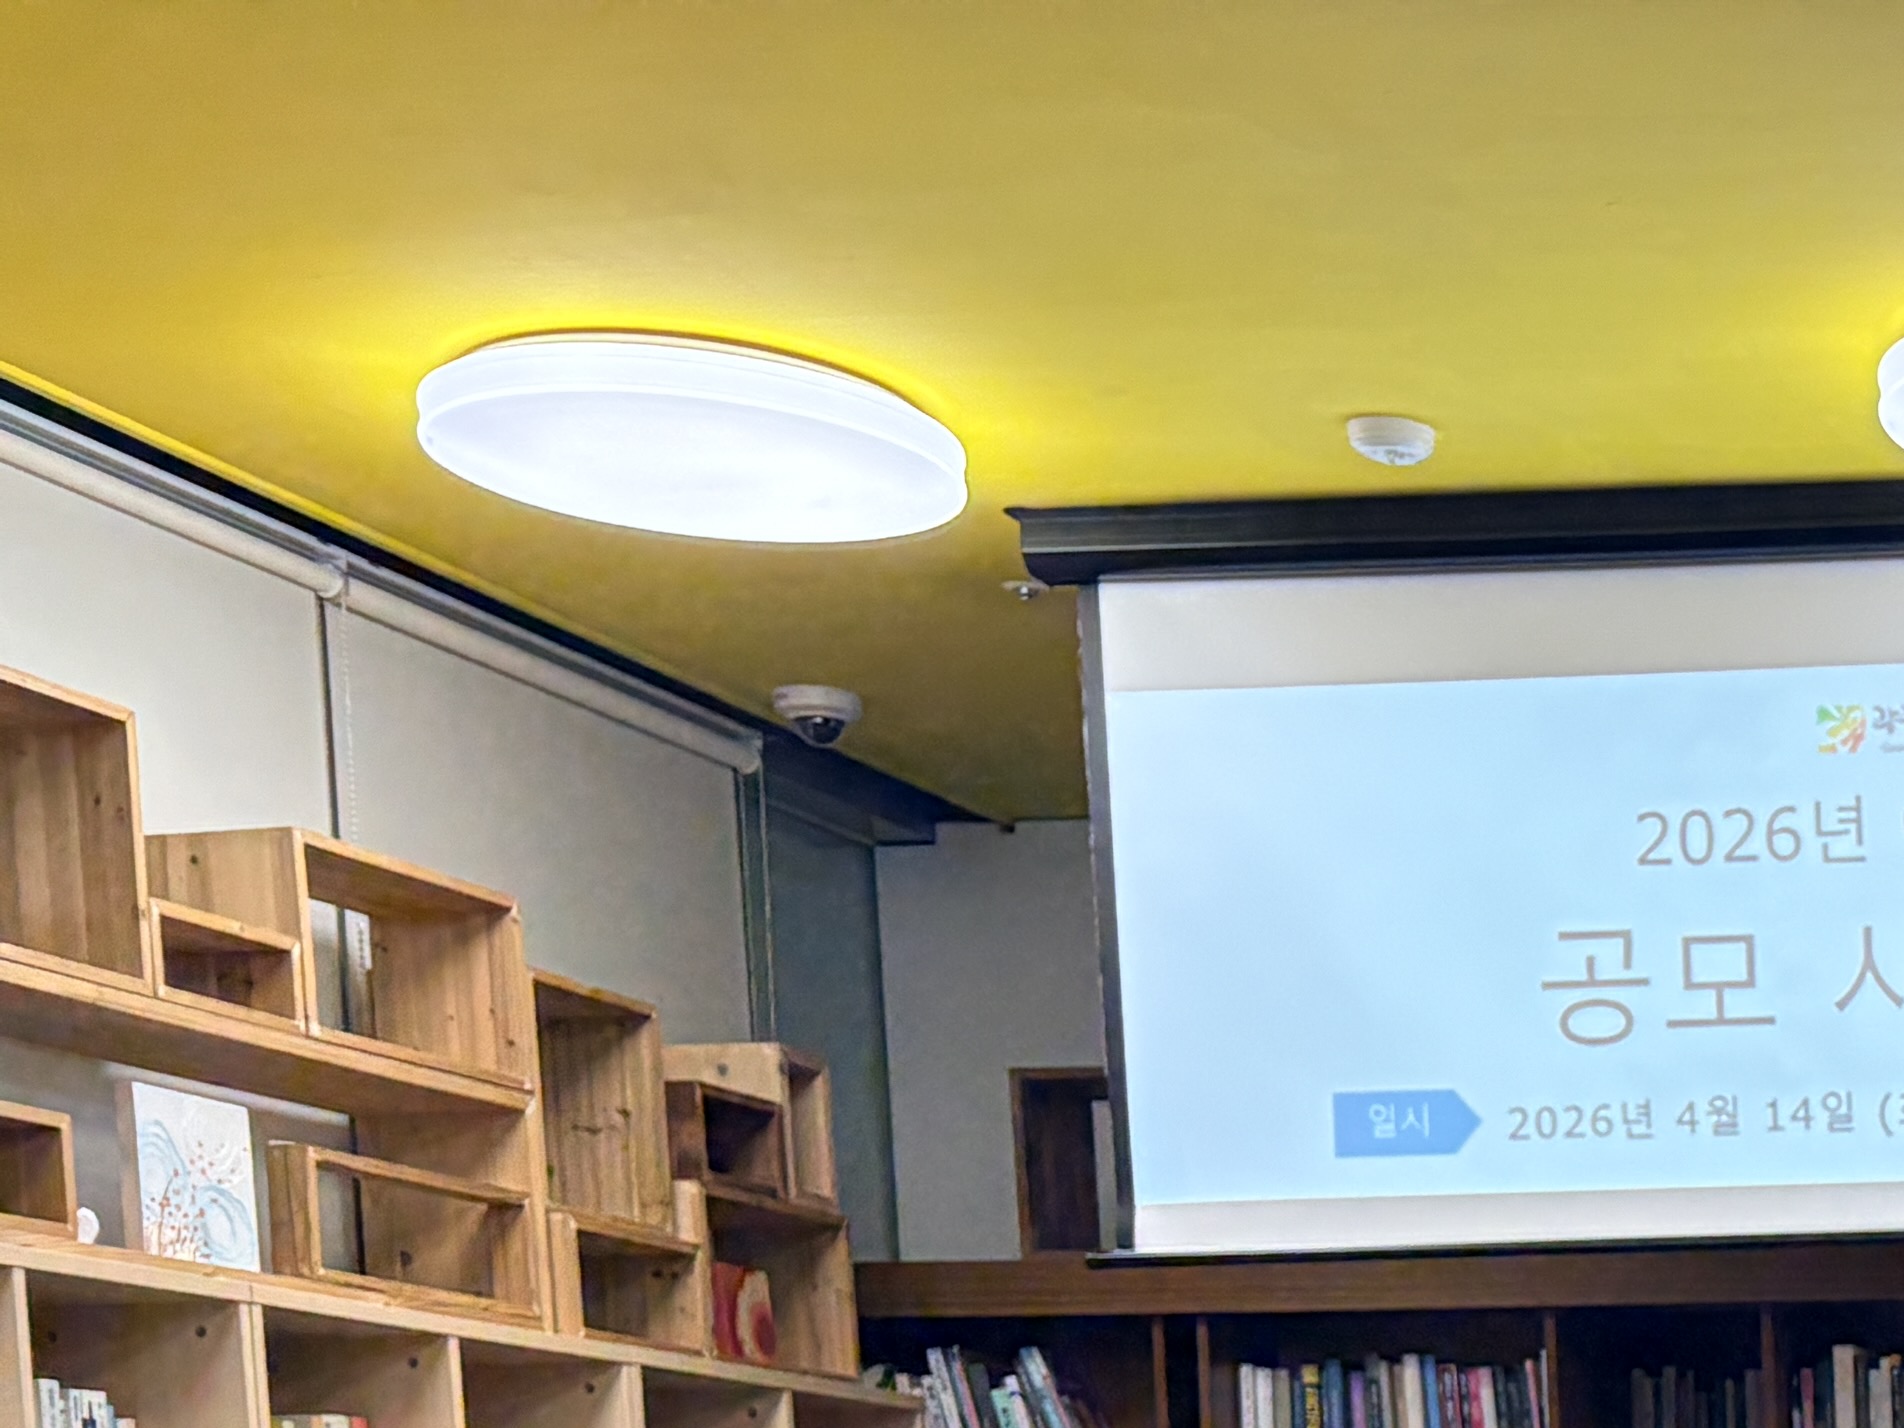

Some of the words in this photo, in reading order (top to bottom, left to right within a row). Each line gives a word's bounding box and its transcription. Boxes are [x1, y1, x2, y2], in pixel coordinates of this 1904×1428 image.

[1635, 795, 1867, 867] 2026년
[1540, 927, 1777, 1047] 공모
[1367, 1103, 1432, 1138] 일시
[1507, 1099, 1655, 1141] 2026년
[1675, 1093, 1742, 1137] 4월
[1765, 1090, 1856, 1134] 14일
